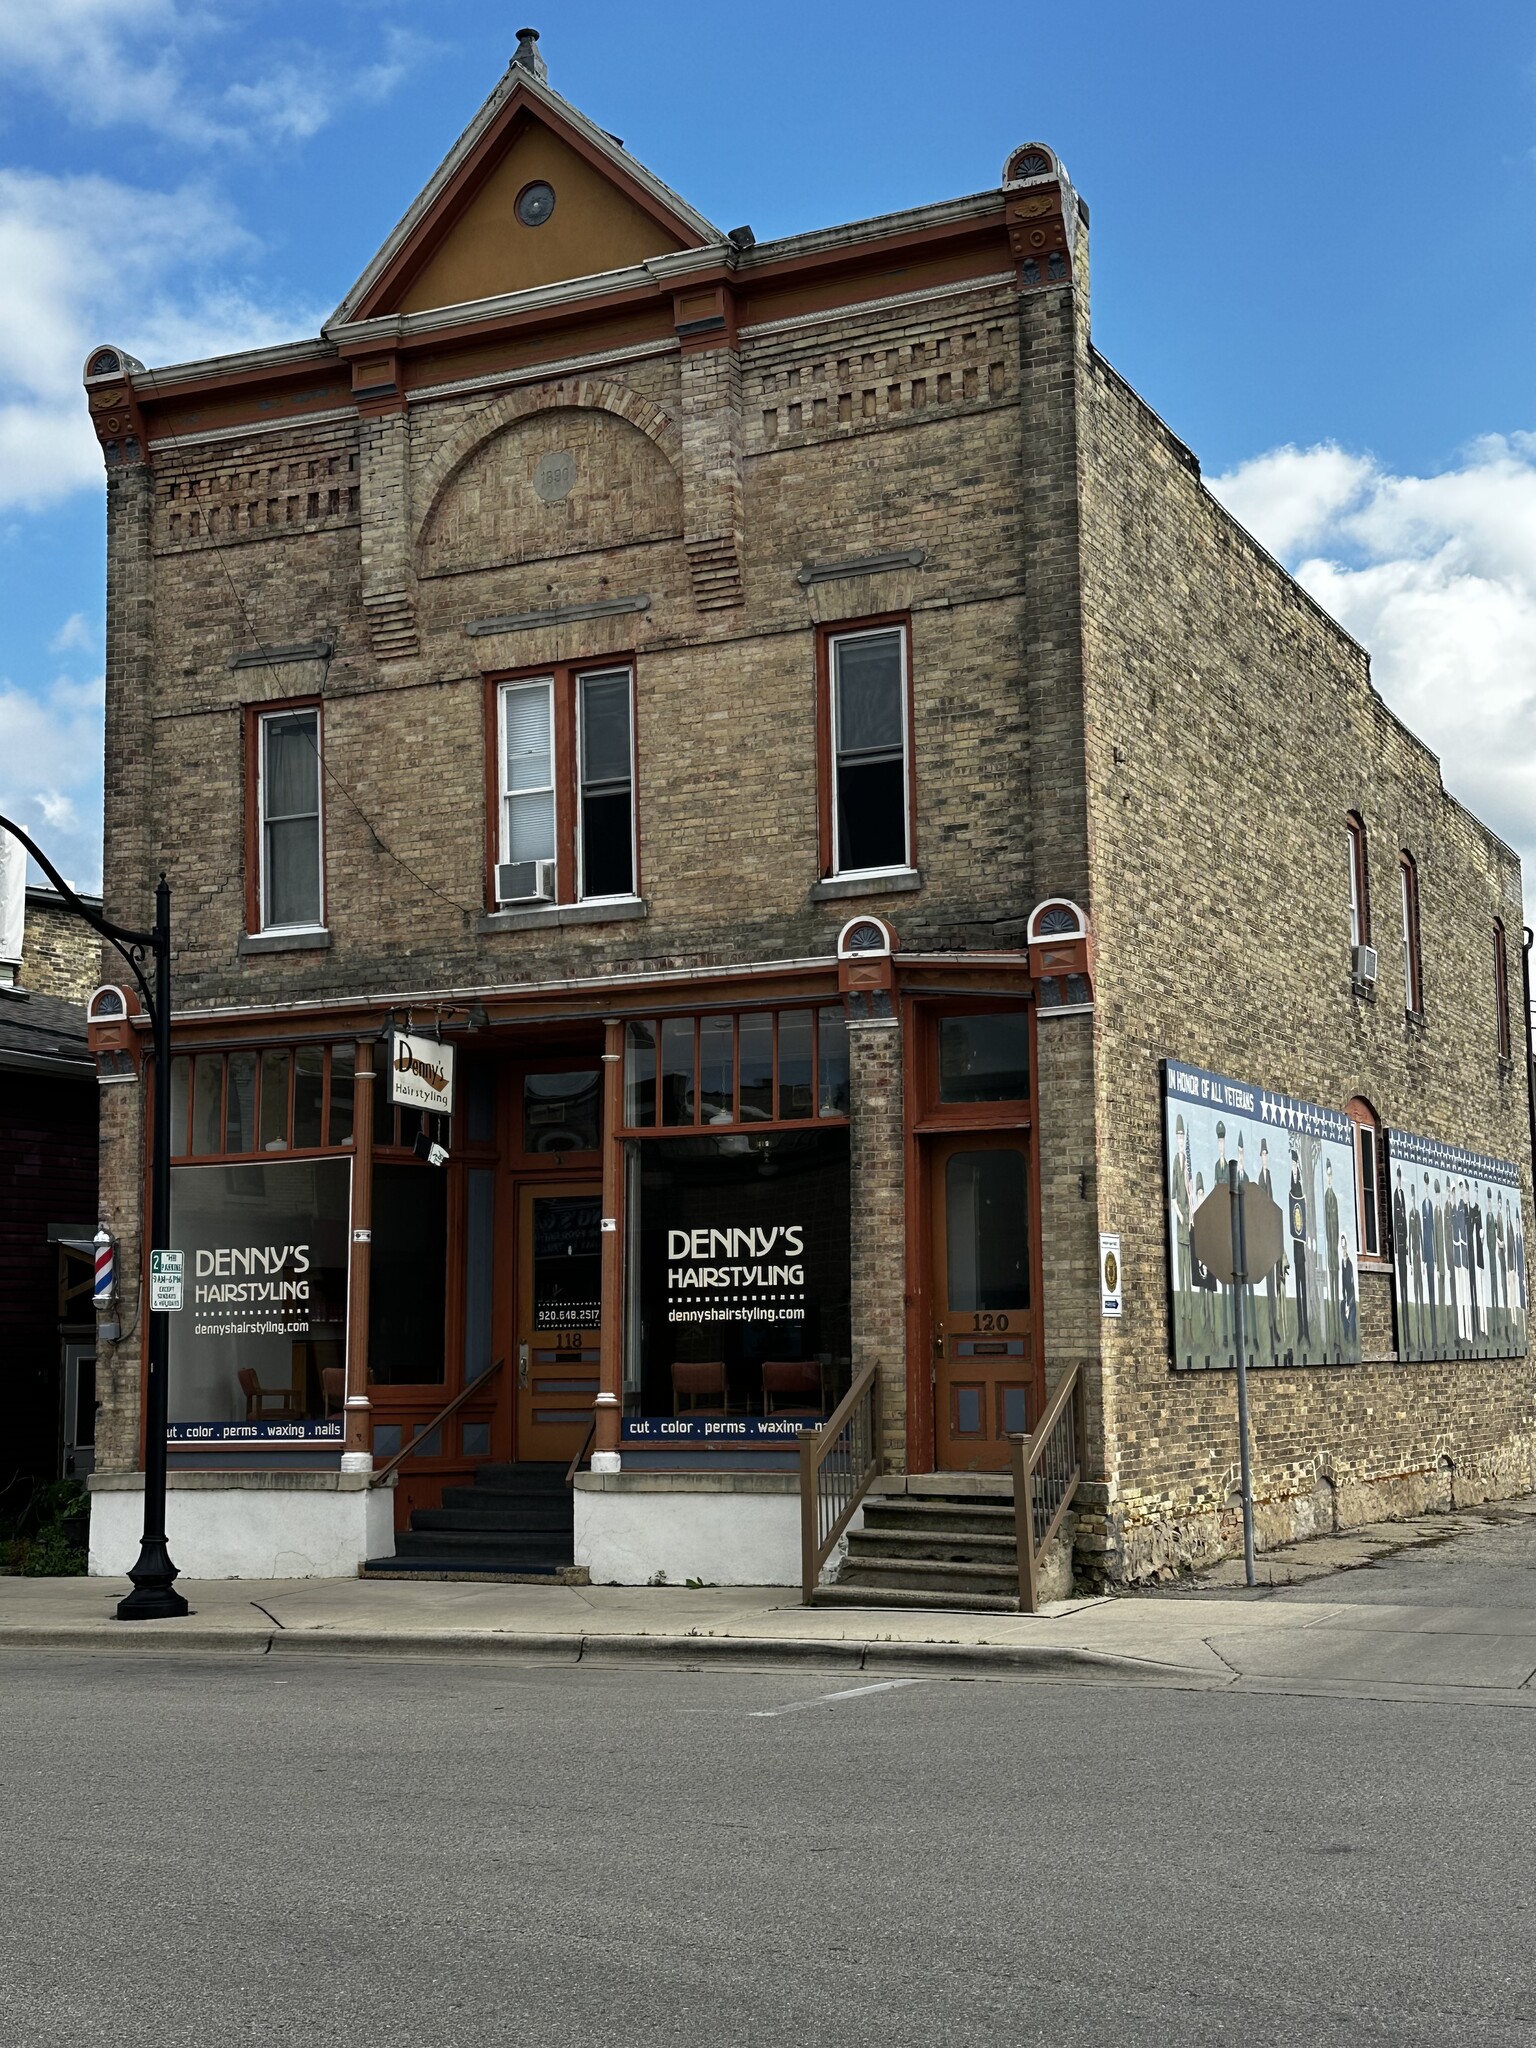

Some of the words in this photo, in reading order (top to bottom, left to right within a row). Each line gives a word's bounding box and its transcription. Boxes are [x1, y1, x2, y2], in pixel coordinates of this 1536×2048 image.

[540, 467, 569, 485] 1890
[399, 1040, 444, 1085] Denny's
[395, 1083, 448, 1107] Hairstyling
[1168, 1068, 1176, 1090] IN
[1176, 1071, 1199, 1097] HONOR
[1201, 1079, 1210, 1099] OF
[1211, 1081, 1223, 1104] ALL
[1224, 1085, 1254, 1113] VETERANS
[668, 1225, 804, 1260] DENNY'S
[153, 1255, 160, 1270] 2
[195, 1245, 310, 1277] DENNY'S
[668, 1264, 804, 1288] HAIRSTYLING
[195, 1281, 310, 1303] HAIRSTYLING
[668, 1307, 805, 1323] dennyshairstyling.com
[973, 1313, 1009, 1332] 120
[195, 1321, 309, 1336] dennyshairstyling.com
[556, 1333, 583, 1349] 118
[166, 1426, 177, 1438] ut
[186, 1426, 214, 1438] color
[223, 1426, 258, 1439] perms
[267, 1423, 305, 1437] waxing
[315, 1423, 341, 1436] nails
[629, 1421, 650, 1434] cut
[661, 1420, 694, 1434] color
[704, 1422, 746, 1436] perms
